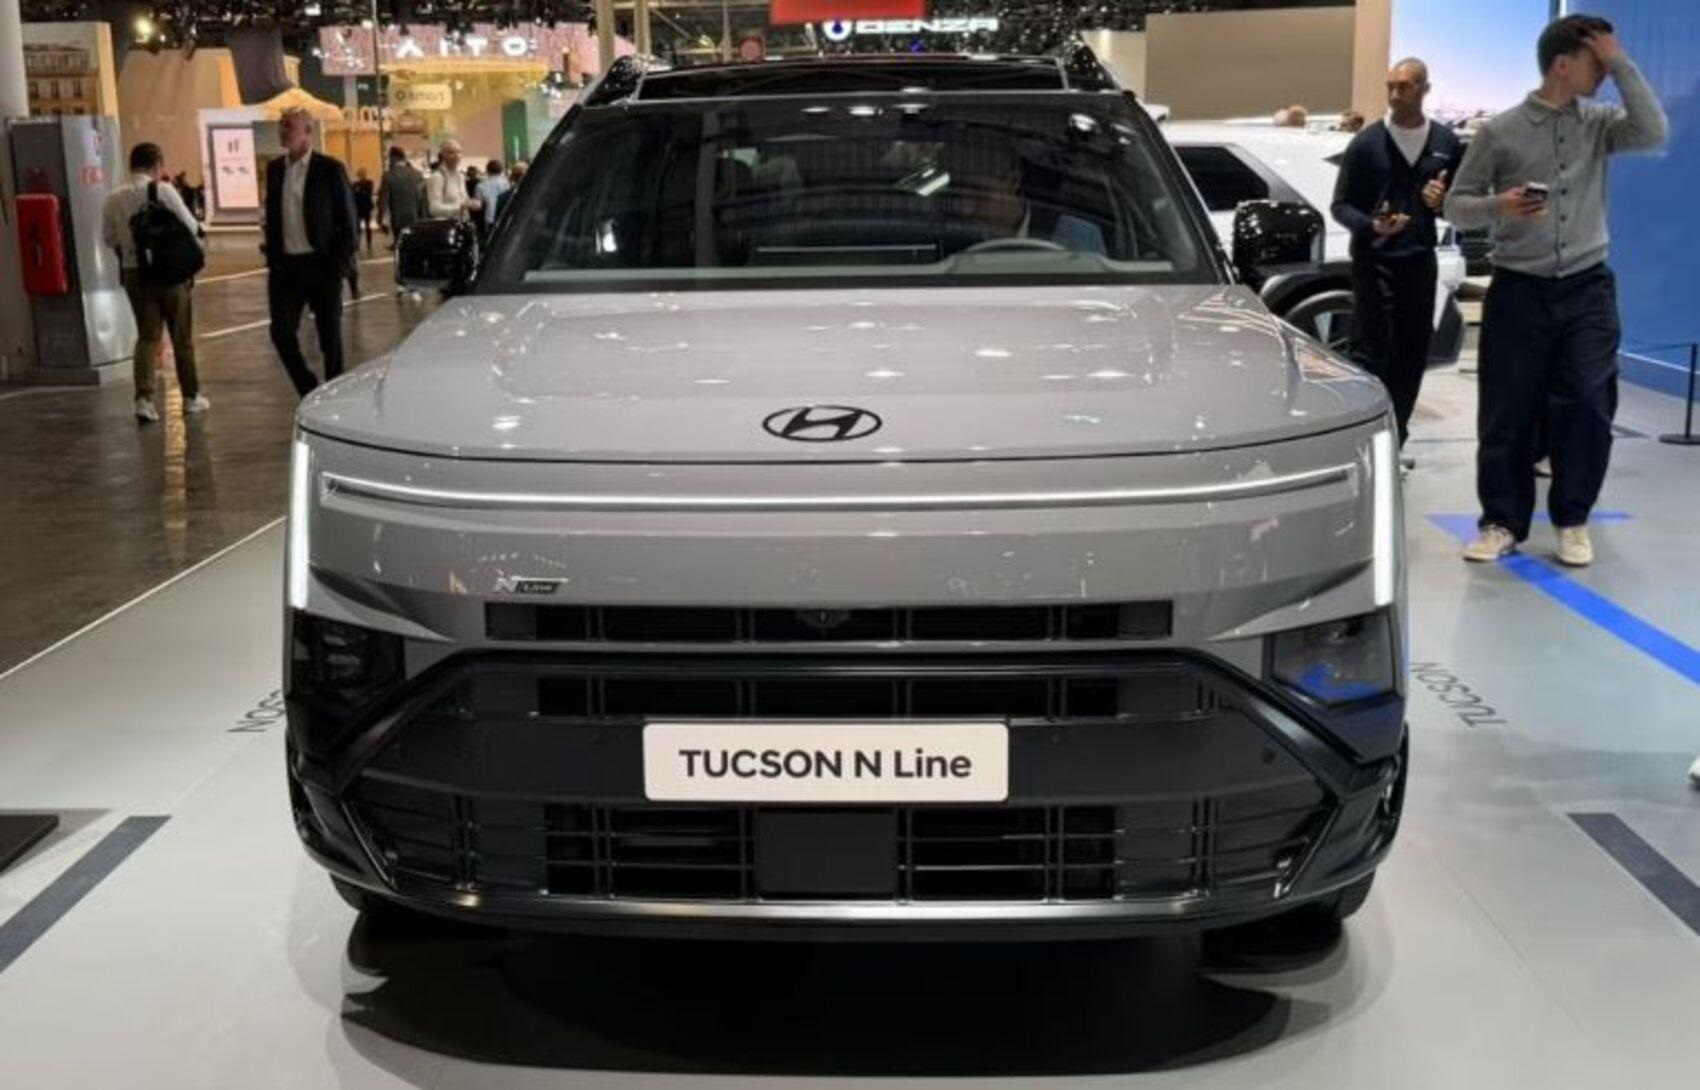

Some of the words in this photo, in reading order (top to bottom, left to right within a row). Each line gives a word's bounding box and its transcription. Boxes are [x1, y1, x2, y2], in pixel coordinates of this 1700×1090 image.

[1410, 662, 1507, 727] TUCSON
[679, 749, 842, 778] TUCSON
[854, 749, 882, 778] N
[894, 748, 972, 778] Line
